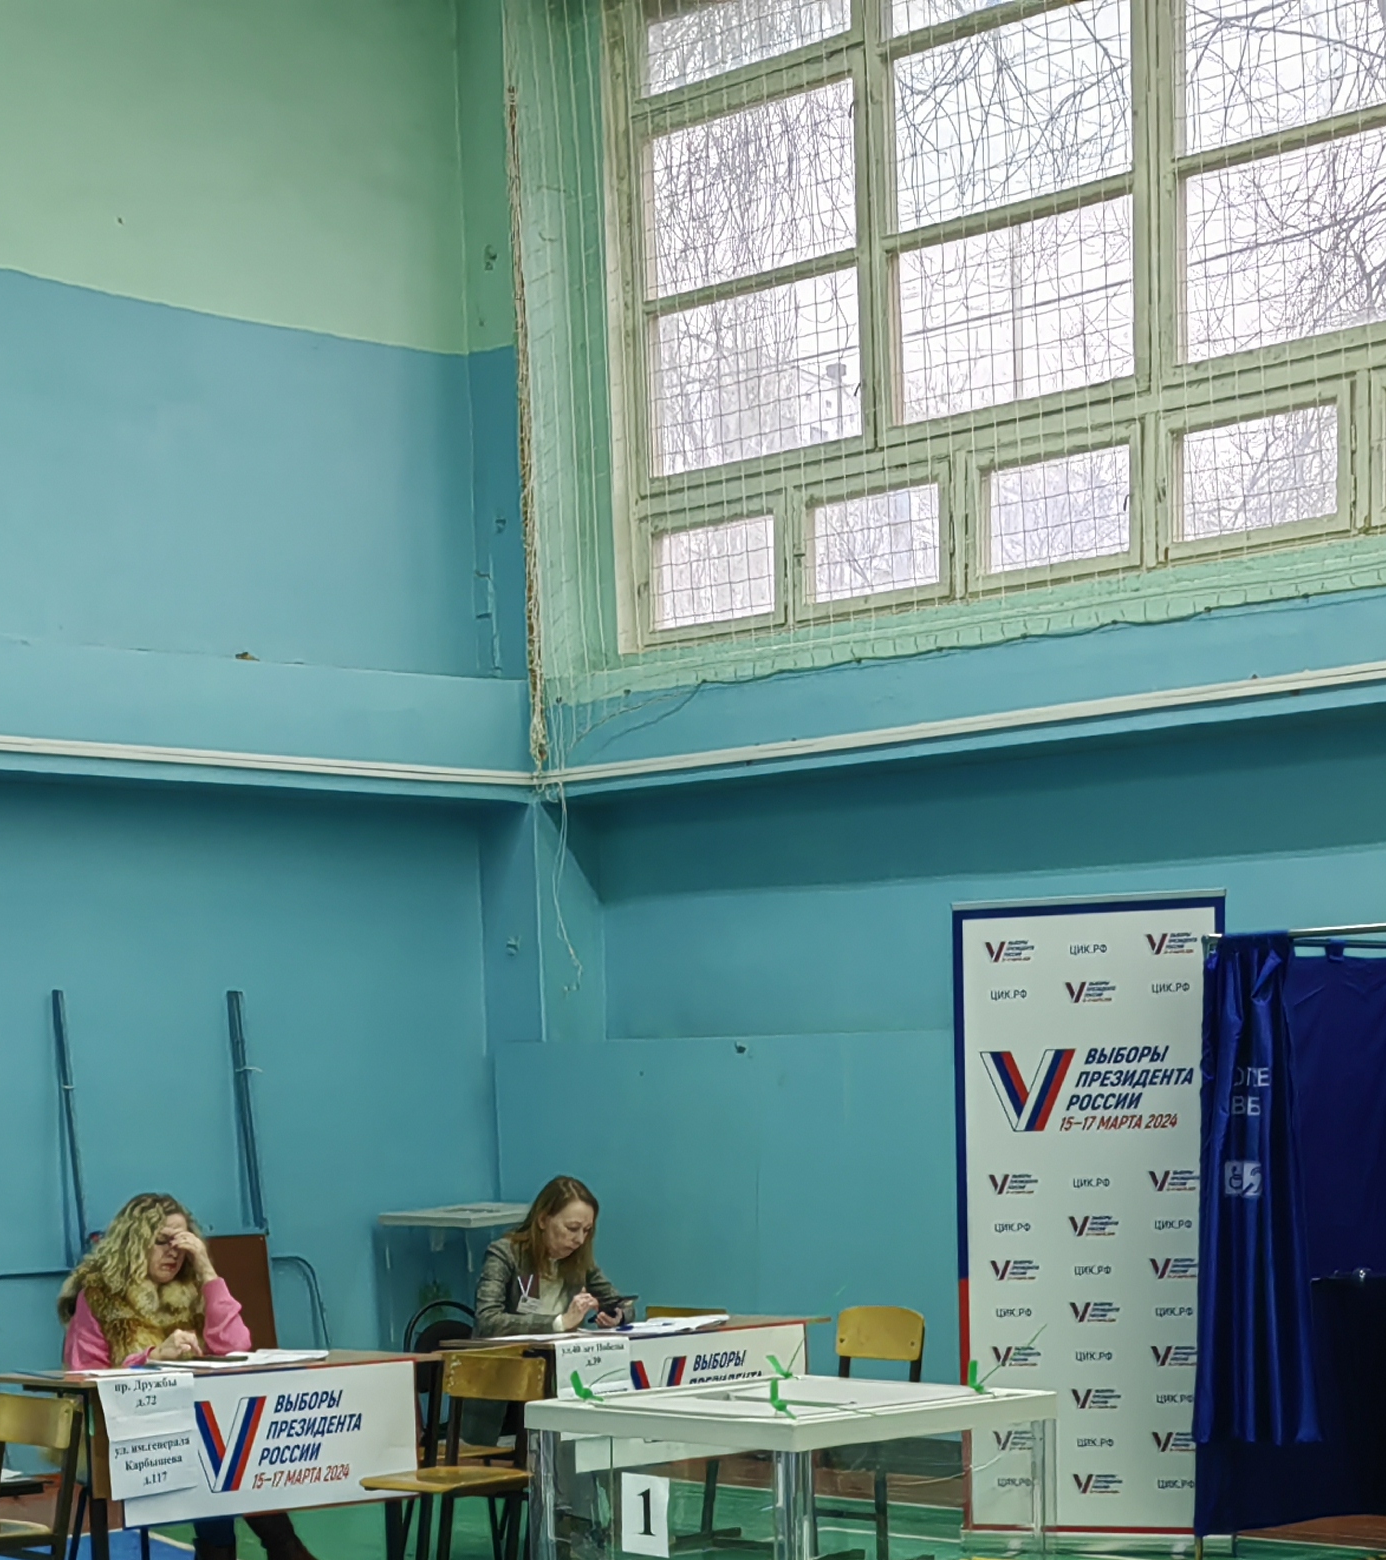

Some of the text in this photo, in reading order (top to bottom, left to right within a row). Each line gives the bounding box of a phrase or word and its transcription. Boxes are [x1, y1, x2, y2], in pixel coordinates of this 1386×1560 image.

[1084, 1045, 1170, 1065] ВЫБОРЫ
[1075, 1068, 1194, 1089] ПРЕЗИДЕНТА
[1065, 1092, 1143, 1111] РОССИИ
[1097, 1114, 1144, 1131] МАРТА
[1144, 1113, 1178, 1130] 2024
[693, 1349, 747, 1372] ВЫБОРЫ
[114, 1377, 177, 1395] пр. Дружбы
[273, 1389, 343, 1414] ВЫБОРЫ
[266, 1413, 362, 1440] ПРЕЗИДЕНТА
[258, 1442, 322, 1466] РОССИИ
[284, 1467, 322, 1487] МАРТА
[324, 1464, 350, 1482] 2024
[636, 1488, 657, 1537] 1
